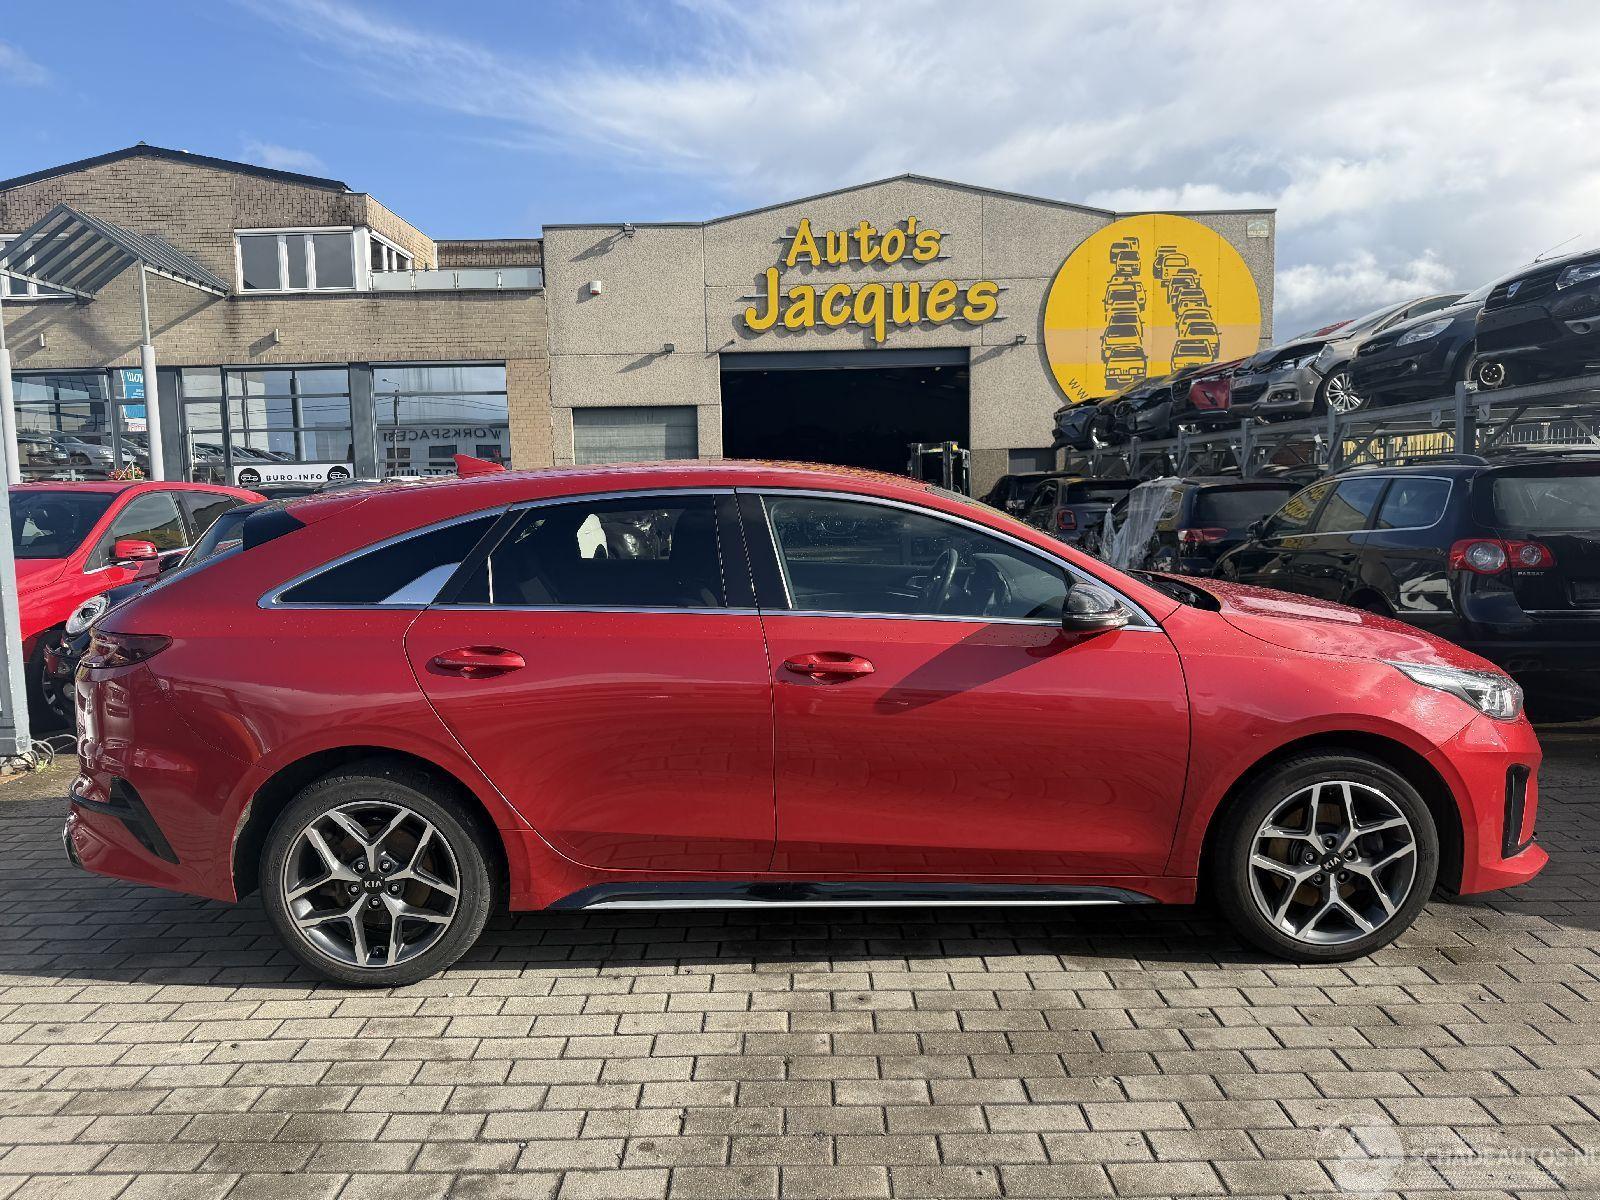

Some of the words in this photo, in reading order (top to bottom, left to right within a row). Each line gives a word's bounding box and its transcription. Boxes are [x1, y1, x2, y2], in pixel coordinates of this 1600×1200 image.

[786, 216, 942, 267] Auto's
[744, 266, 1000, 343] Jacques
[265, 473, 323, 482] BURO-INFO
[1323, 856, 1341, 870] KIA
[364, 880, 382, 888] KIA
